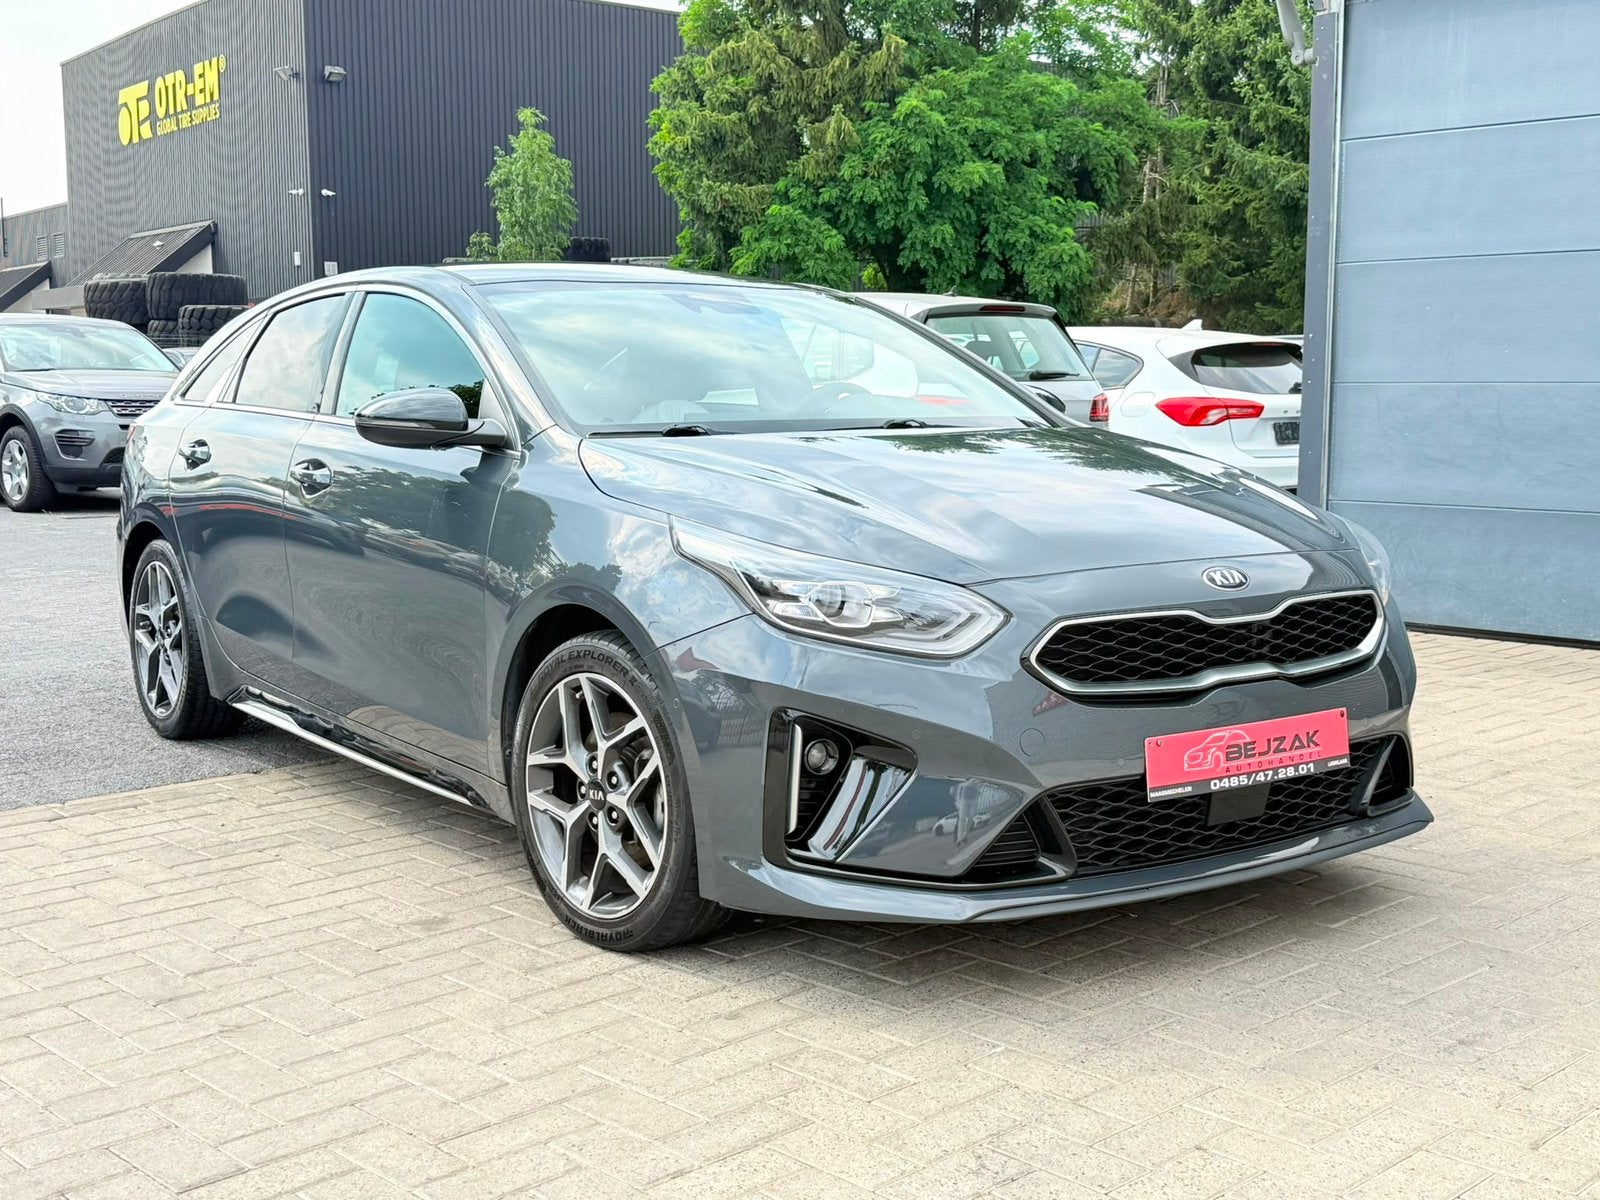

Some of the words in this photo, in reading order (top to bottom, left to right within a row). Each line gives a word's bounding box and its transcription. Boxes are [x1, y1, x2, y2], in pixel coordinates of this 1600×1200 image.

[154, 56, 220, 119] OTR-EM
[157, 115, 178, 136] GLOBAL
[191, 103, 220, 126] SUPPLIES
[1208, 569, 1247, 586] KIA
[568, 649, 629, 678] EXPLORER
[1225, 729, 1321, 762] BEJZAK
[1210, 762, 1315, 790] 0485/47.28.01
[1225, 751, 1323, 774] AUTOHANDEL
[589, 788, 605, 801] KIA
